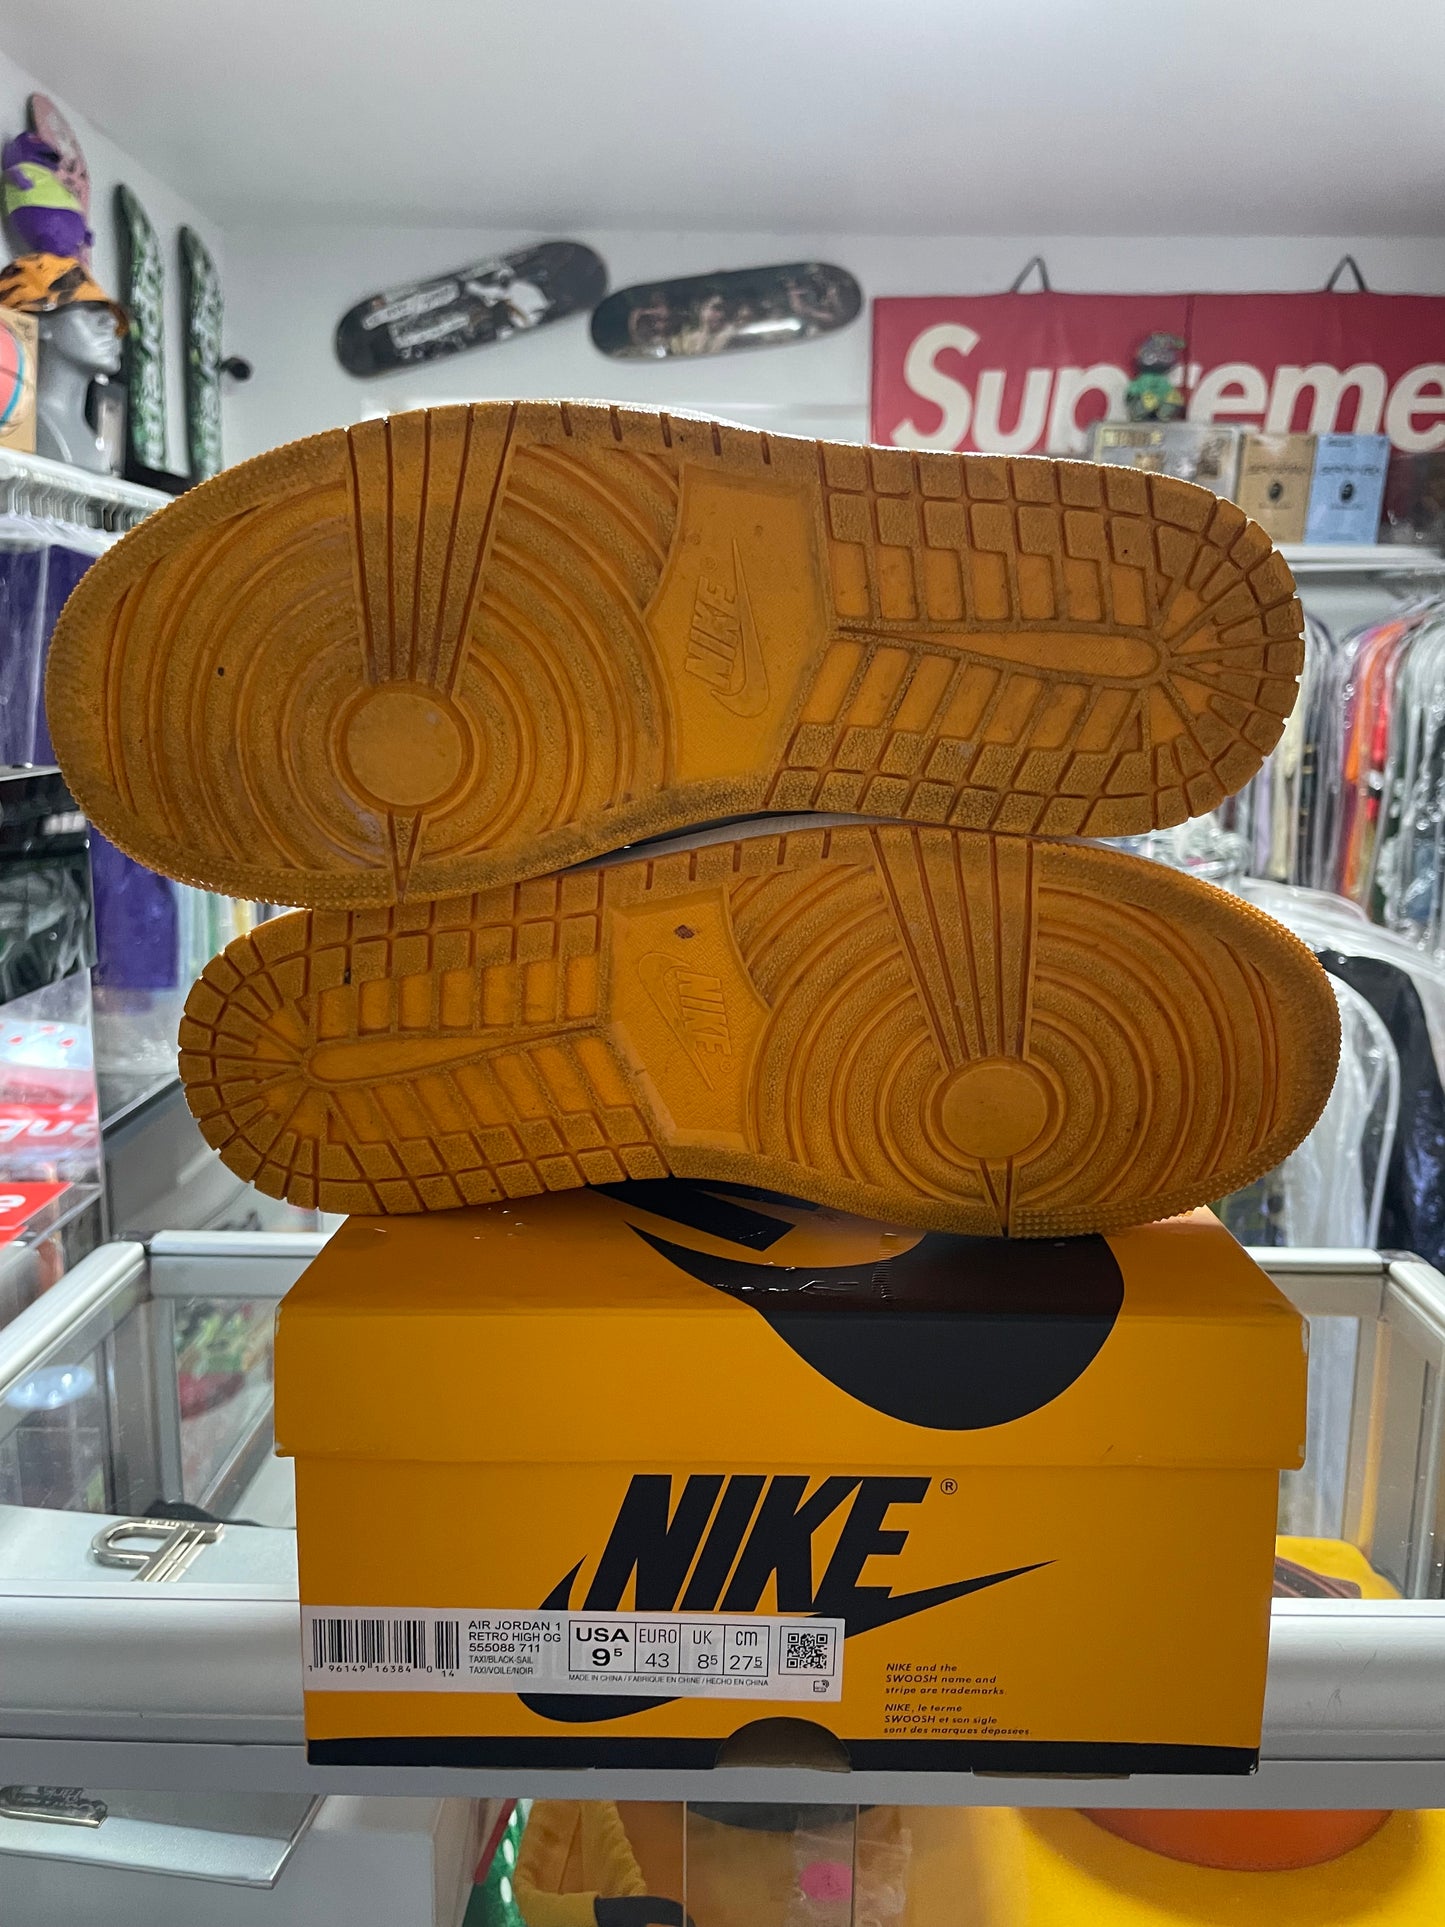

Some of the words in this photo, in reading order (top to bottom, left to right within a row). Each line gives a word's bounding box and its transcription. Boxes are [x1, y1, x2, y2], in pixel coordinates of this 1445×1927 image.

[891, 321, 1445, 453] Supeme
[685, 576, 740, 690] NIKE
[677, 971, 732, 1056] NIKE
[581, 1473, 932, 1613] NIKE
[468, 1620, 491, 1630] AIR
[494, 1621, 550, 1631] JORDAN
[555, 1622, 561, 1631] 1
[468, 1632, 509, 1641] RETRO
[512, 1632, 540, 1642] HIGH
[543, 1633, 561, 1643] OG
[576, 1627, 630, 1643] USA
[639, 1629, 677, 1644] EURO
[693, 1629, 713, 1645] UK
[735, 1630, 758, 1646] cm
[469, 1643, 516, 1653] 555088
[519, 1643, 540, 1653] 711
[645, 1653, 669, 1668] 43
[442, 1669, 455, 1677] 14
[886, 1663, 912, 1672] NIKE
[915, 1664, 937, 1672] and
[940, 1663, 958, 1672] the
[627, 1675, 663, 1683] FABRIQUE
[705, 1677, 732, 1685] HECHO
[886, 1674, 938, 1683] SWOOSH
[975, 1675, 997, 1683] and
[885, 1686, 916, 1695] stripe
[917, 1703, 928, 1712] le
[930, 1704, 962, 1712] terme
[884, 1714, 936, 1723] SWOOSH
[952, 1716, 970, 1724] son
[973, 1715, 998, 1725] sigle
[884, 1726, 907, 1734] sont
[910, 1726, 928, 1734] des
[931, 1727, 978, 1735] marques
